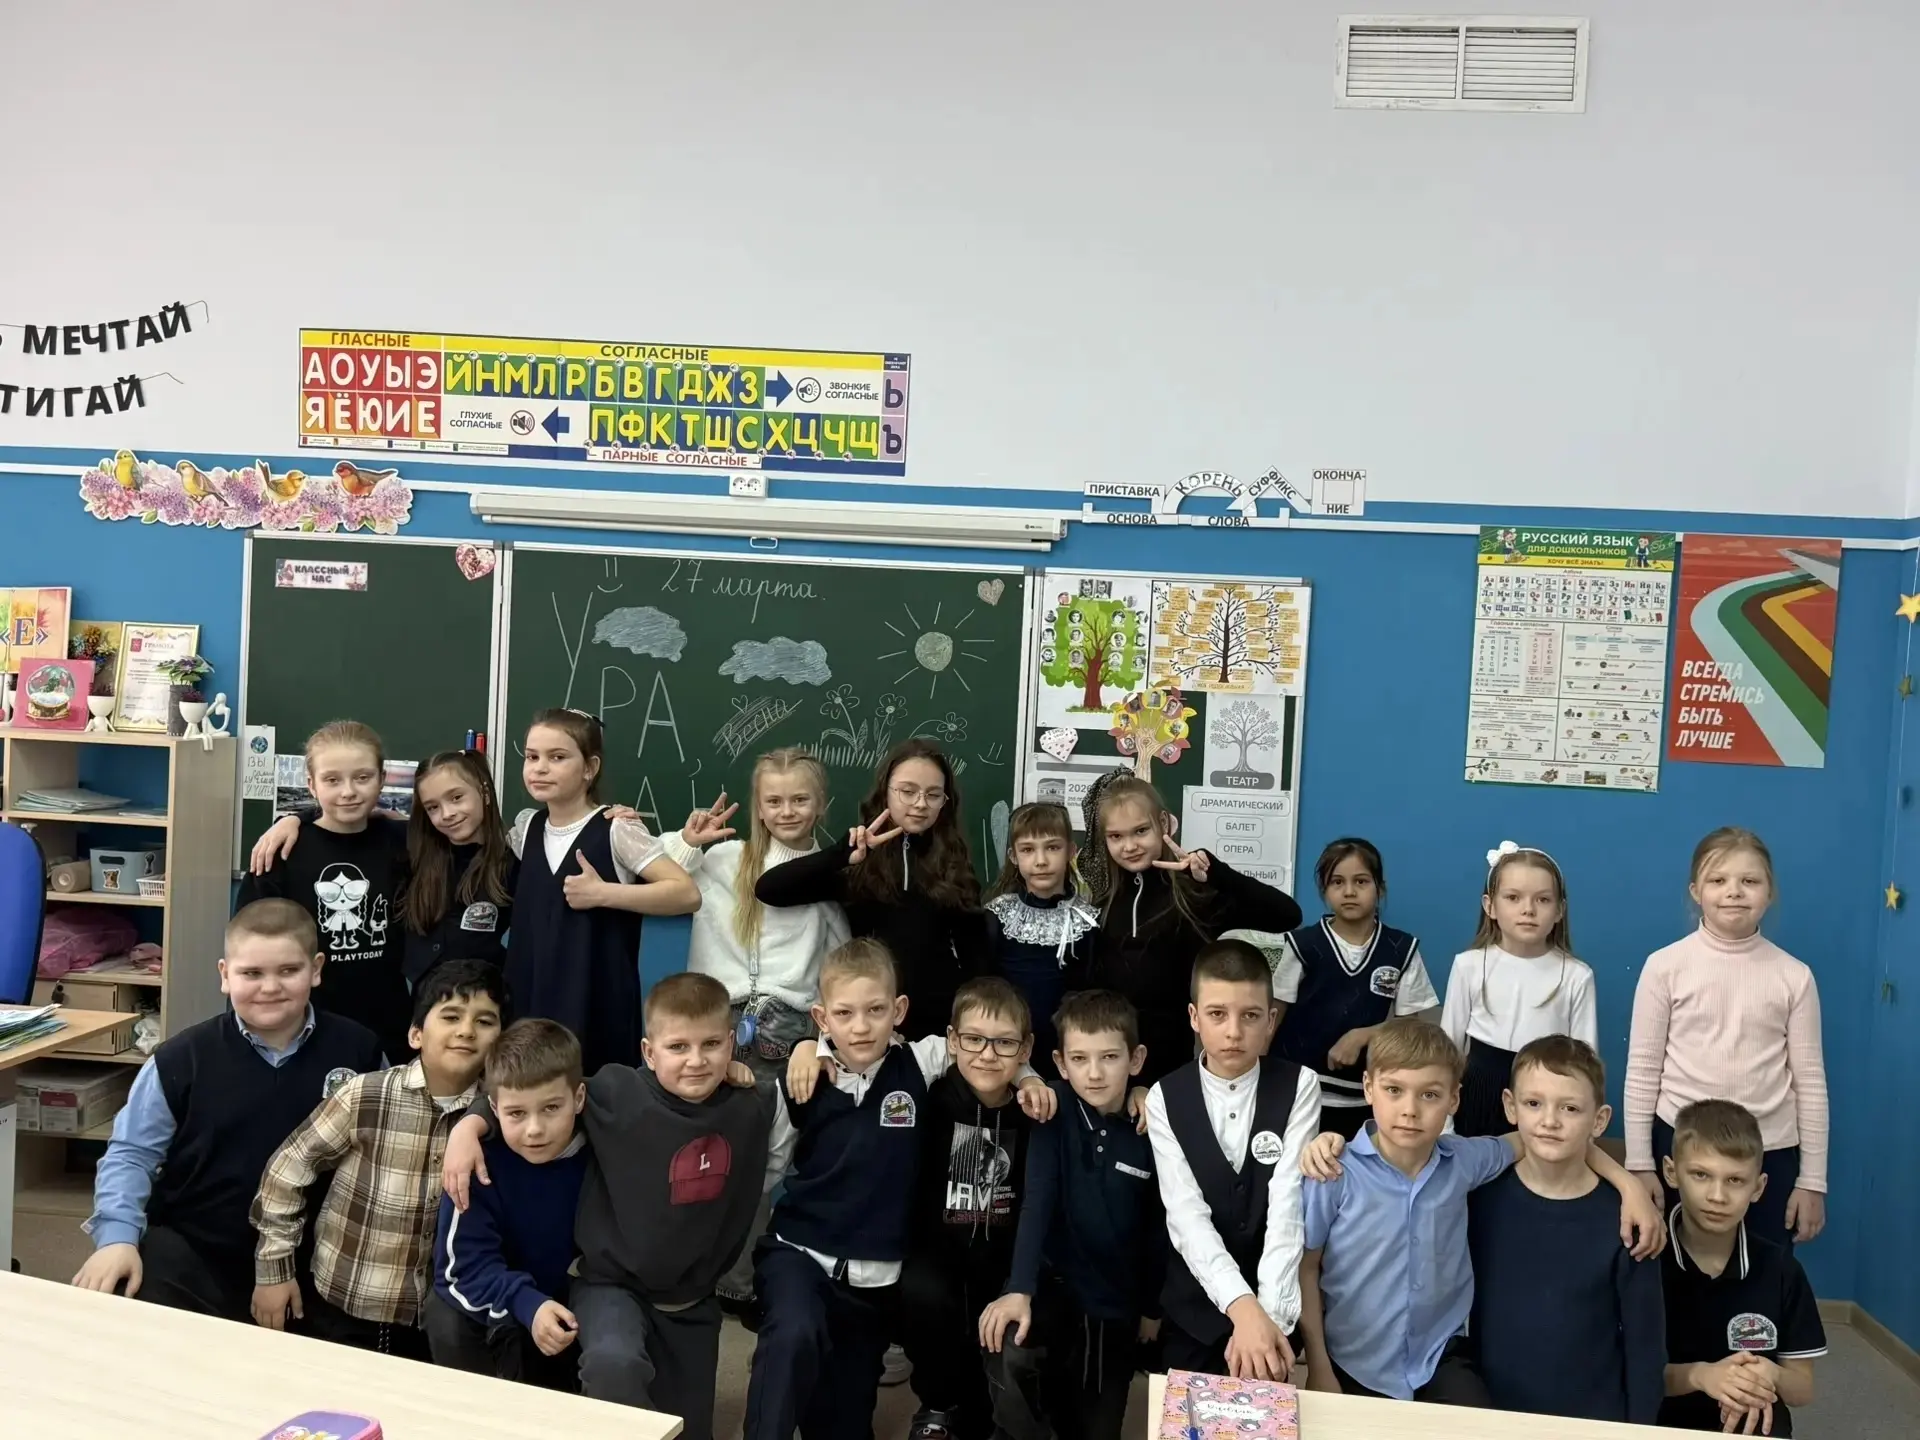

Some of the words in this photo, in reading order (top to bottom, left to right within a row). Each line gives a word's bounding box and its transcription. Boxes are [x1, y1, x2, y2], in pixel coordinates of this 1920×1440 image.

[23, 301, 192, 356] МЕЧТАЙ
[331, 332, 411, 348] ГЛАСНЫЕ
[600, 344, 709, 361] СОГЛАСНЫЕ
[829, 381, 871, 391] ЗВОНКИЕ
[825, 390, 880, 401] СОГЛАСНЫЕ
[459, 410, 493, 421] ГЛУХИЕ
[449, 418, 503, 430] СОГЛАСНЫЕ
[602, 449, 659, 462] ПАРНЫЕ
[665, 453, 748, 467] СОГЛАСНЫЕ
[1089, 483, 1161, 498] ПРИСТАВКА
[1175, 472, 1243, 499] КОРЕНЬ
[1326, 503, 1350, 515] НИЕ
[1106, 513, 1158, 526] ОСНОВА
[1207, 515, 1250, 528] СЛОВА
[1521, 532, 1588, 545] РУССКИЙ
[1593, 536, 1635, 547] ЯЗЫК
[1527, 545, 1547, 554] ДЛЯ
[1548, 546, 1628, 556] ДОШКОЛЬНИКОВ
[295, 564, 349, 576] КЛАССНЫЙ
[661, 558, 704, 594] 27
[311, 574, 333, 584] ЧАС
[1681, 660, 1744, 682] ВСЕГДА
[1679, 683, 1766, 704] СТРЕМИСЬ
[1677, 706, 1724, 726] БЫТЬ
[1675, 729, 1735, 750] ЛУЧШЕ
[1225, 775, 1260, 787] ТЕАТР
[1200, 798, 1284, 811] ДРАМАТИЧЕСКИЙ
[1225, 822, 1257, 832] БАЛЕТ
[1223, 845, 1255, 854] ОПЕРА
[331, 950, 384, 962] PLAYTODAY
[699, 1153, 711, 1171] L
